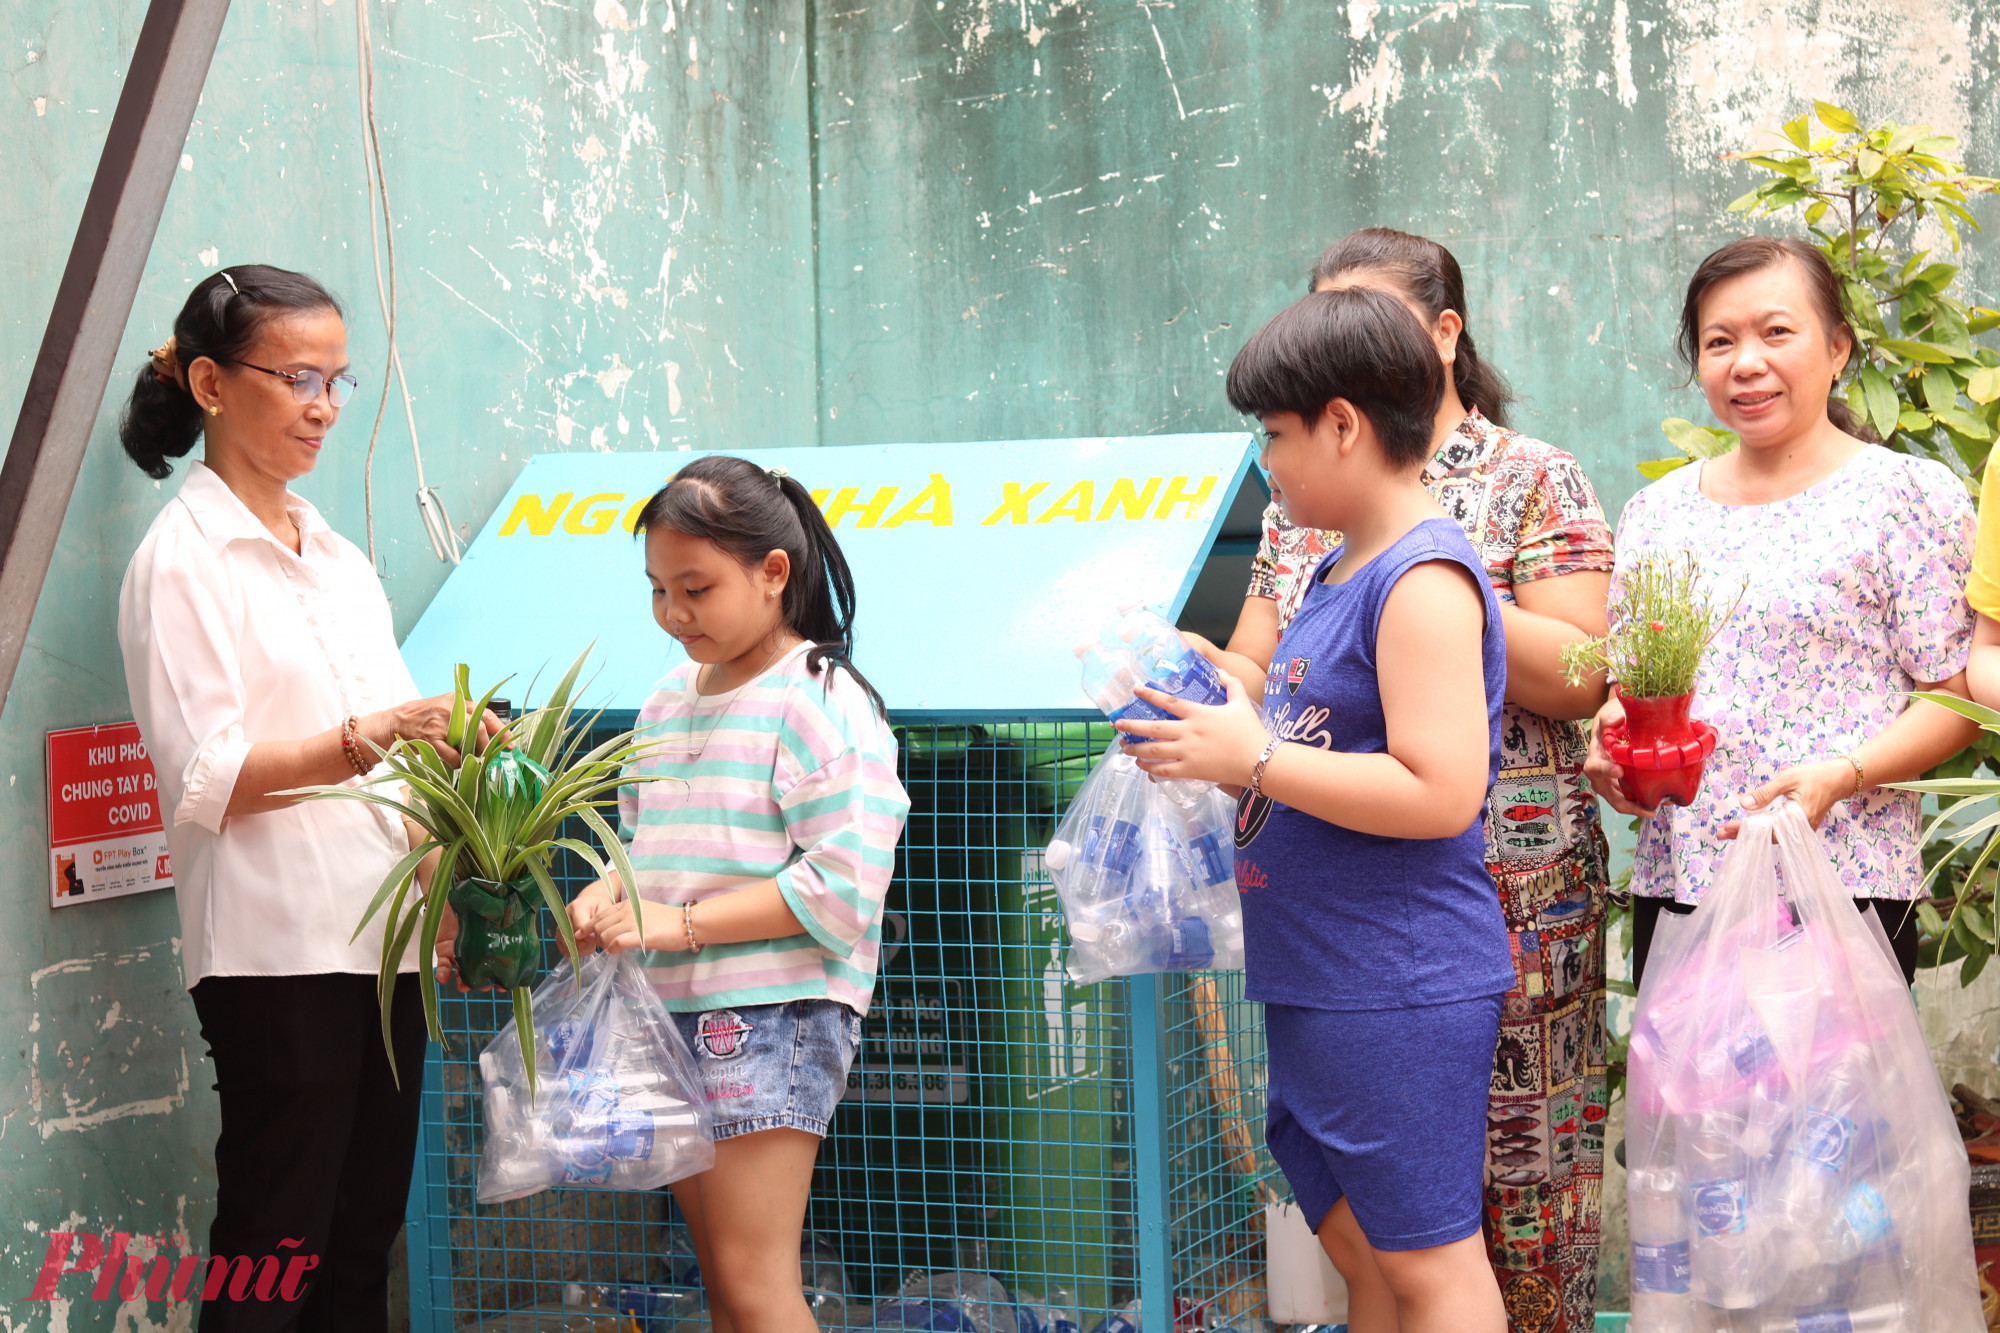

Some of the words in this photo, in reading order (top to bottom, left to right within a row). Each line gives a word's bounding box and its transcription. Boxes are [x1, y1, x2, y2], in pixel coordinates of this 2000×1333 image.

[497, 491, 658, 537] NG
[980, 475, 1219, 525] XANH
[88, 745, 116, 767] KHU
[61, 778, 114, 802] CHUNG
[116, 774, 140, 795] TAY
[108, 801, 152, 825] COVID
[104, 850, 117, 861] FPT
[117, 848, 132, 860] Play
[870, 1026, 944, 1054] THÙNG
